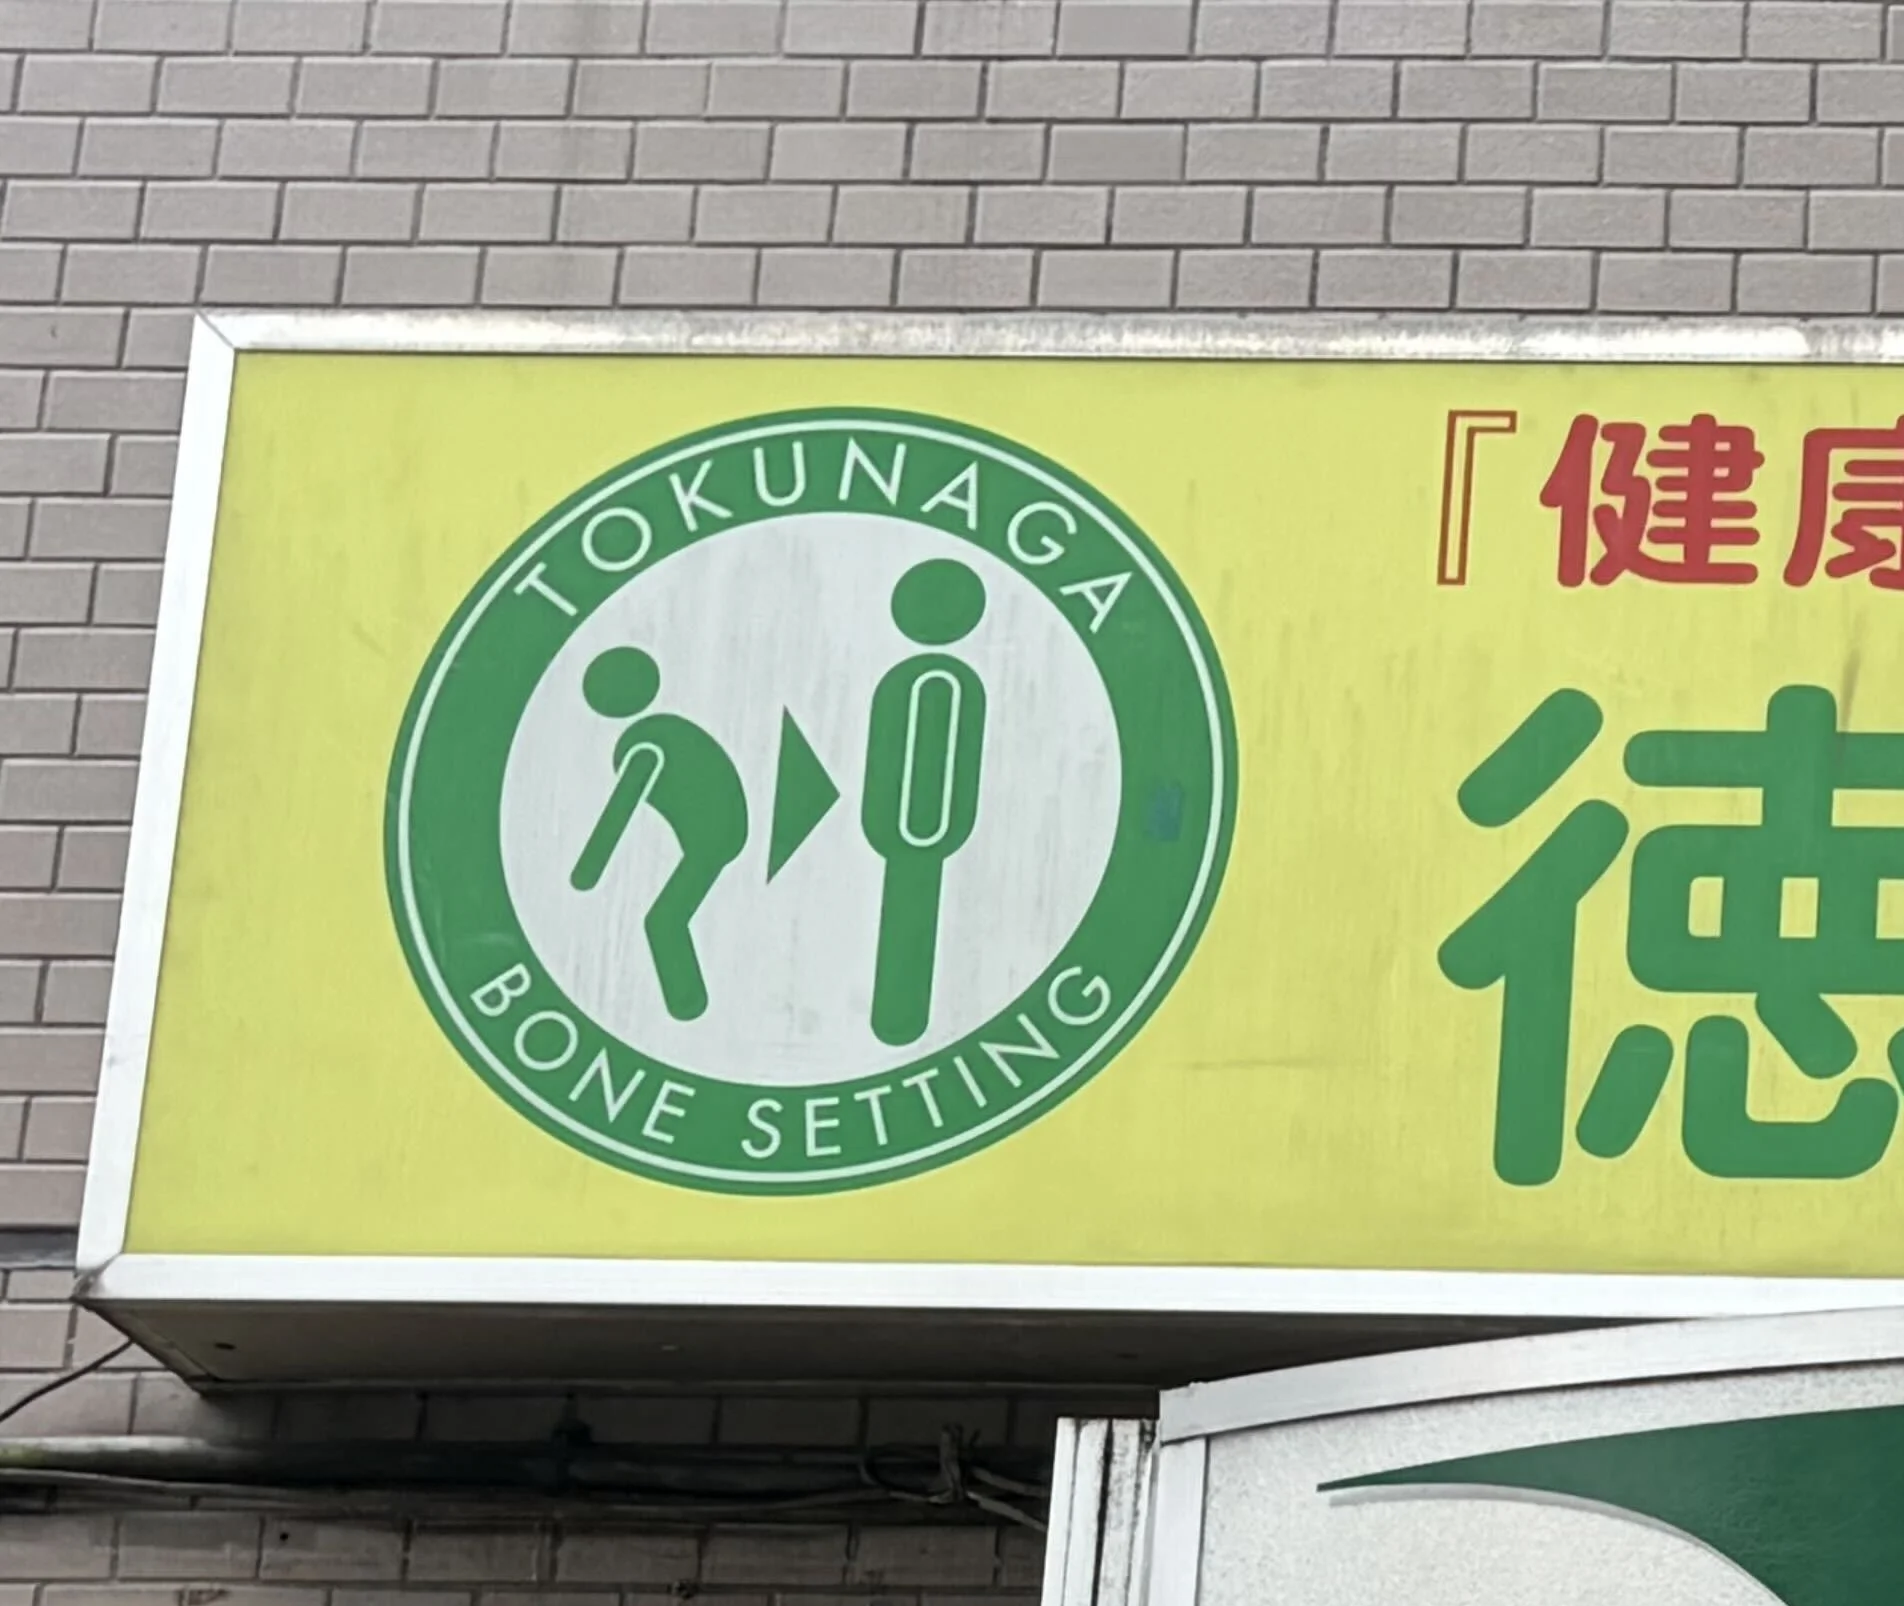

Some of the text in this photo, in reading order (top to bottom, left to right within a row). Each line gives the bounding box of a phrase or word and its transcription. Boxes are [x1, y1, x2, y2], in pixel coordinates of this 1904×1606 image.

[515, 437, 1133, 633] TOKUNAGA
[471, 962, 1111, 1158] BONE SETTING
